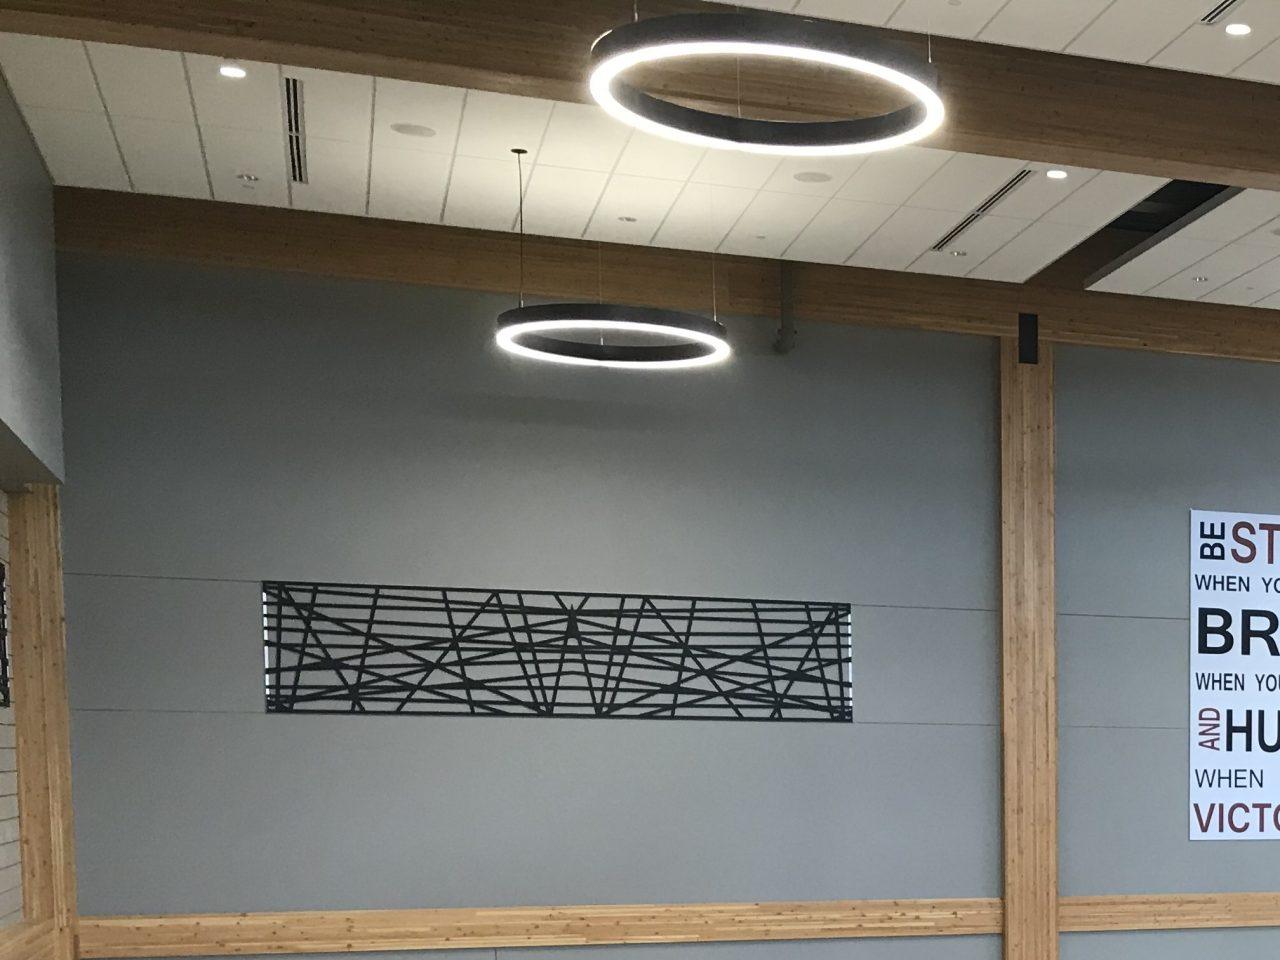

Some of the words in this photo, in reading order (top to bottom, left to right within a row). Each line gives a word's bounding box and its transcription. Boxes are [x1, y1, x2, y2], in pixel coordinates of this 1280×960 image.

[1200, 521, 1225, 560] BE
[1195, 574, 1250, 593] WHEN
[1195, 672, 1245, 691] WHEN
[1198, 707, 1220, 752] AND
[1195, 769, 1264, 789] WHEN
